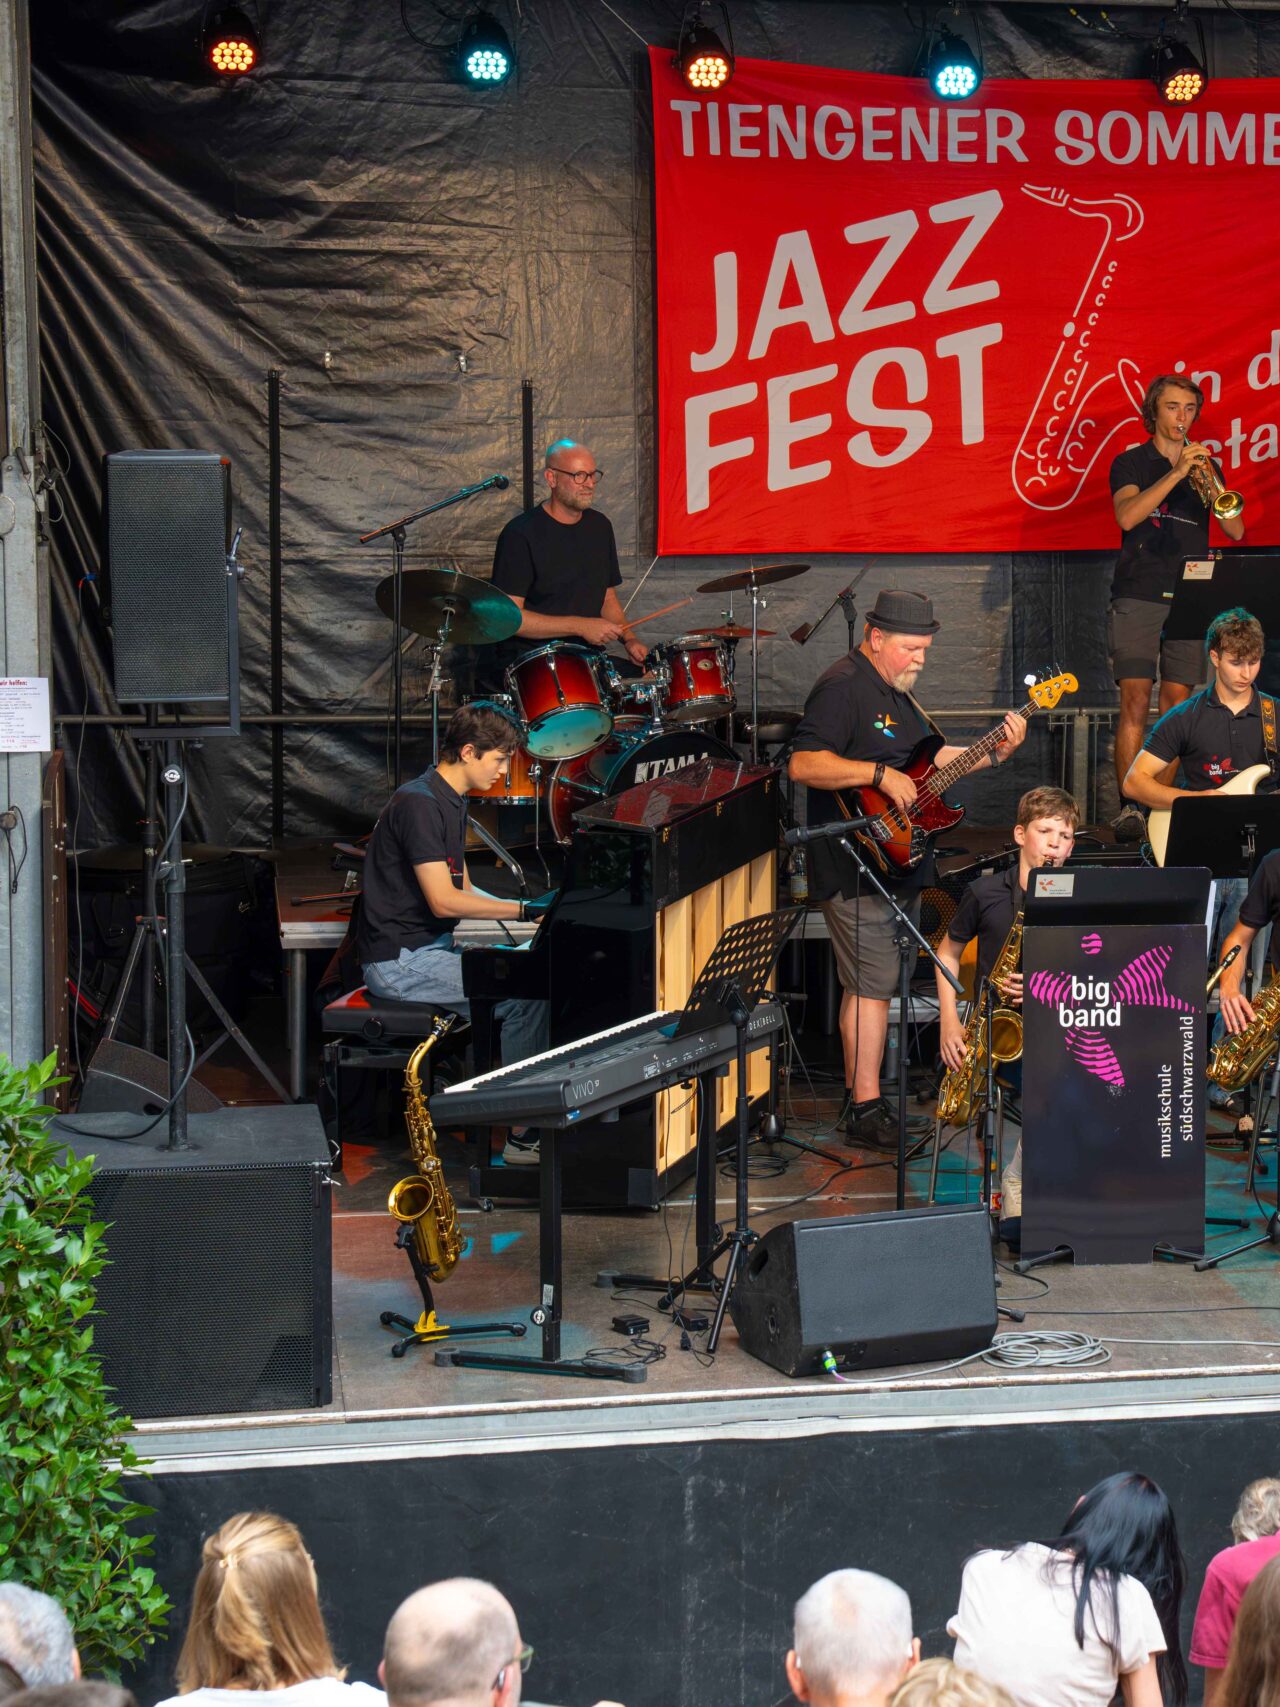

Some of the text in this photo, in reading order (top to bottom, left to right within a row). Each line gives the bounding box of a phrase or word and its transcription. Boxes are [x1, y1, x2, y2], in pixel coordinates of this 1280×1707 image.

[670, 100, 1028, 165] TIENGENER
[690, 189, 1003, 372] JAZZ
[685, 323, 1003, 515] FEST
[1058, 1003, 1121, 1027] band
[1071, 976, 1110, 1006] big
[573, 1080, 593, 1099] VIVO
[1160, 1064, 1172, 1158] musikschule
[1179, 1016, 1193, 1141] südschwarzwald
